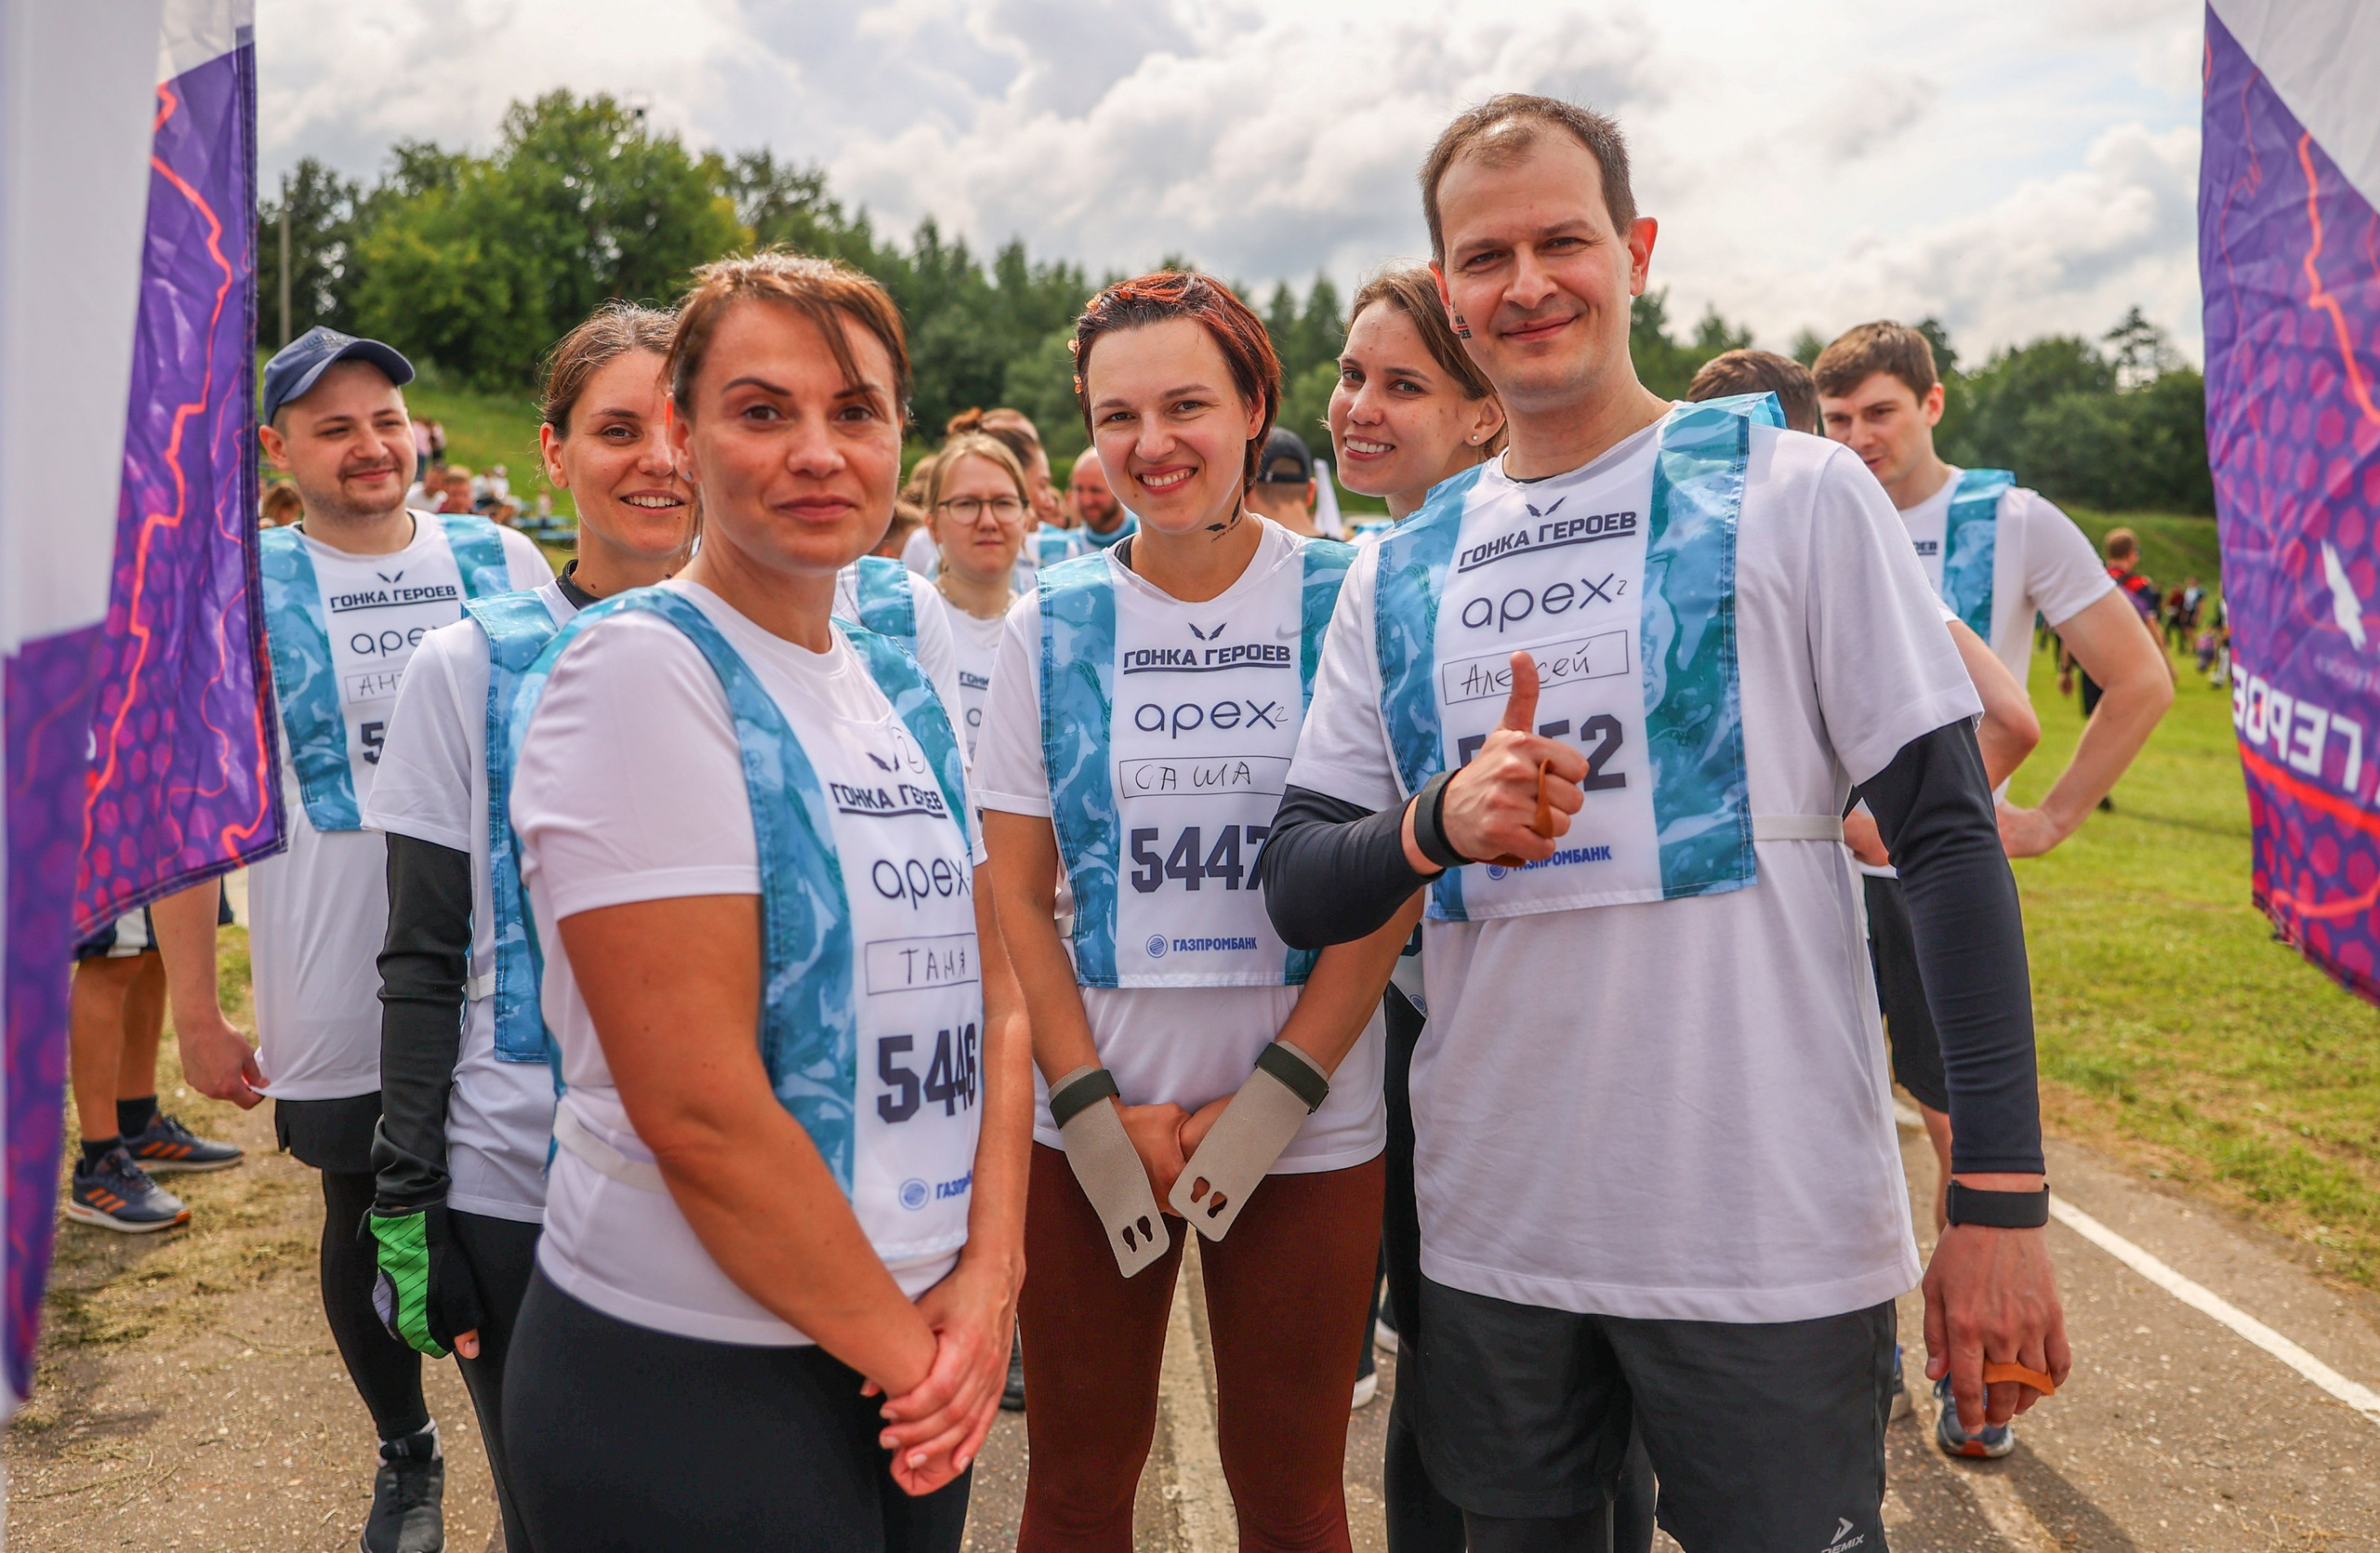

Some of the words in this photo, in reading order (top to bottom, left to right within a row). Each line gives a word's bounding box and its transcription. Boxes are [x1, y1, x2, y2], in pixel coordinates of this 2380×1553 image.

[1459, 530, 1530, 567] ГОНКА
[1539, 511, 1637, 543] ГЕРОЕВ
[330, 591, 389, 609] ГОНКА
[393, 585, 457, 602] ГЕРОЕВ
[1461, 573, 1614, 633] apex
[350, 625, 442, 658] ape
[1124, 649, 1197, 669] ГОНКА
[1205, 644, 1291, 666] ГЕРОЕВ
[1461, 641, 1592, 696] Алесей
[1134, 699, 1276, 739] apex
[1135, 761, 1251, 790] САША
[829, 783, 895, 809] ГОНКА
[898, 784, 944, 810] ГЕЕВ
[1130, 825, 1272, 894] 5447
[872, 857, 970, 910] apex
[1172, 937, 1258, 952] ГАЗПРОМБАНК
[898, 947, 966, 985] ТАНЯ
[877, 1023, 976, 1124] 5446
